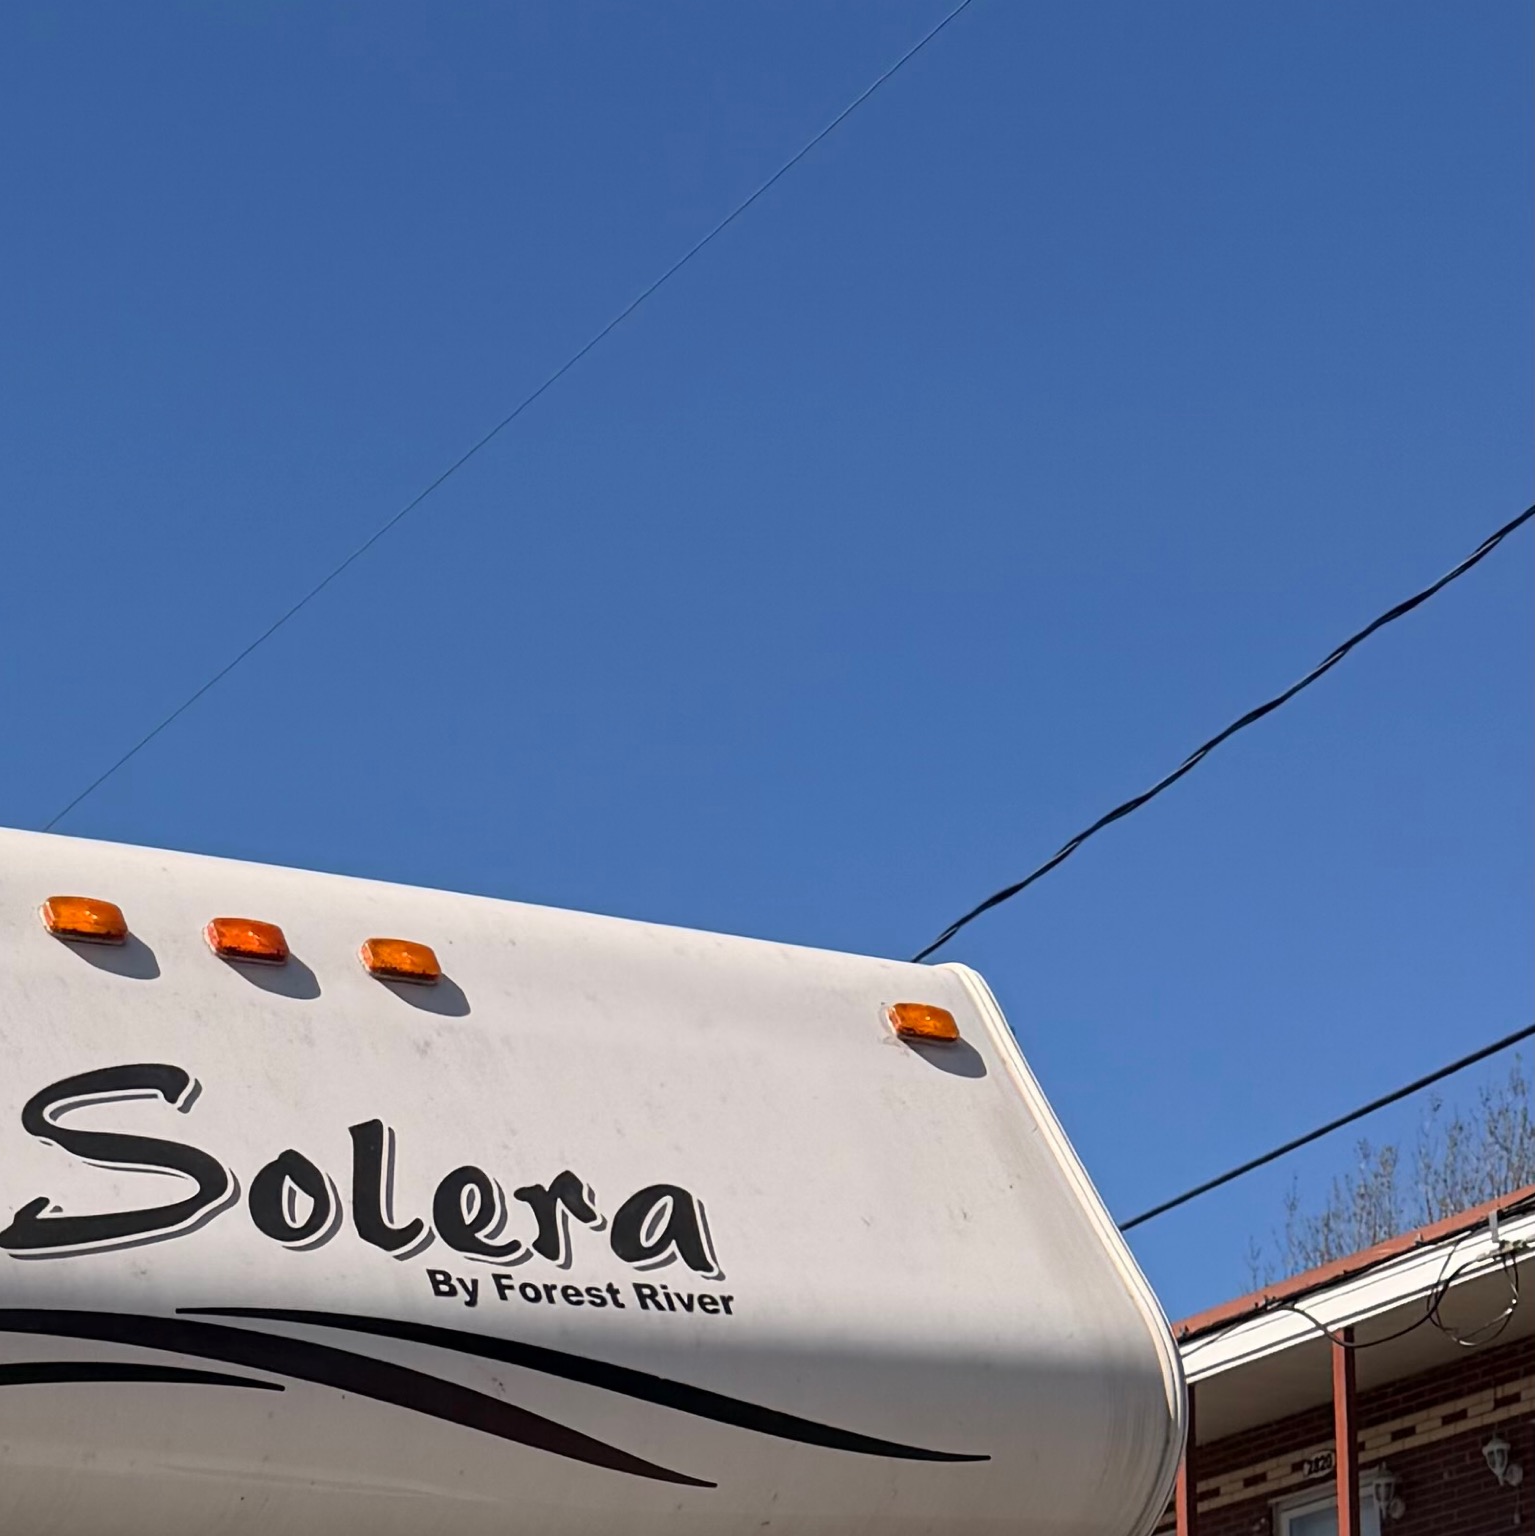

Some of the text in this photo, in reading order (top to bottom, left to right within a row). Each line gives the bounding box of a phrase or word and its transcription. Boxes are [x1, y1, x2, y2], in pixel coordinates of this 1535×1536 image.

[426, 1268, 735, 1316] By Forest River
